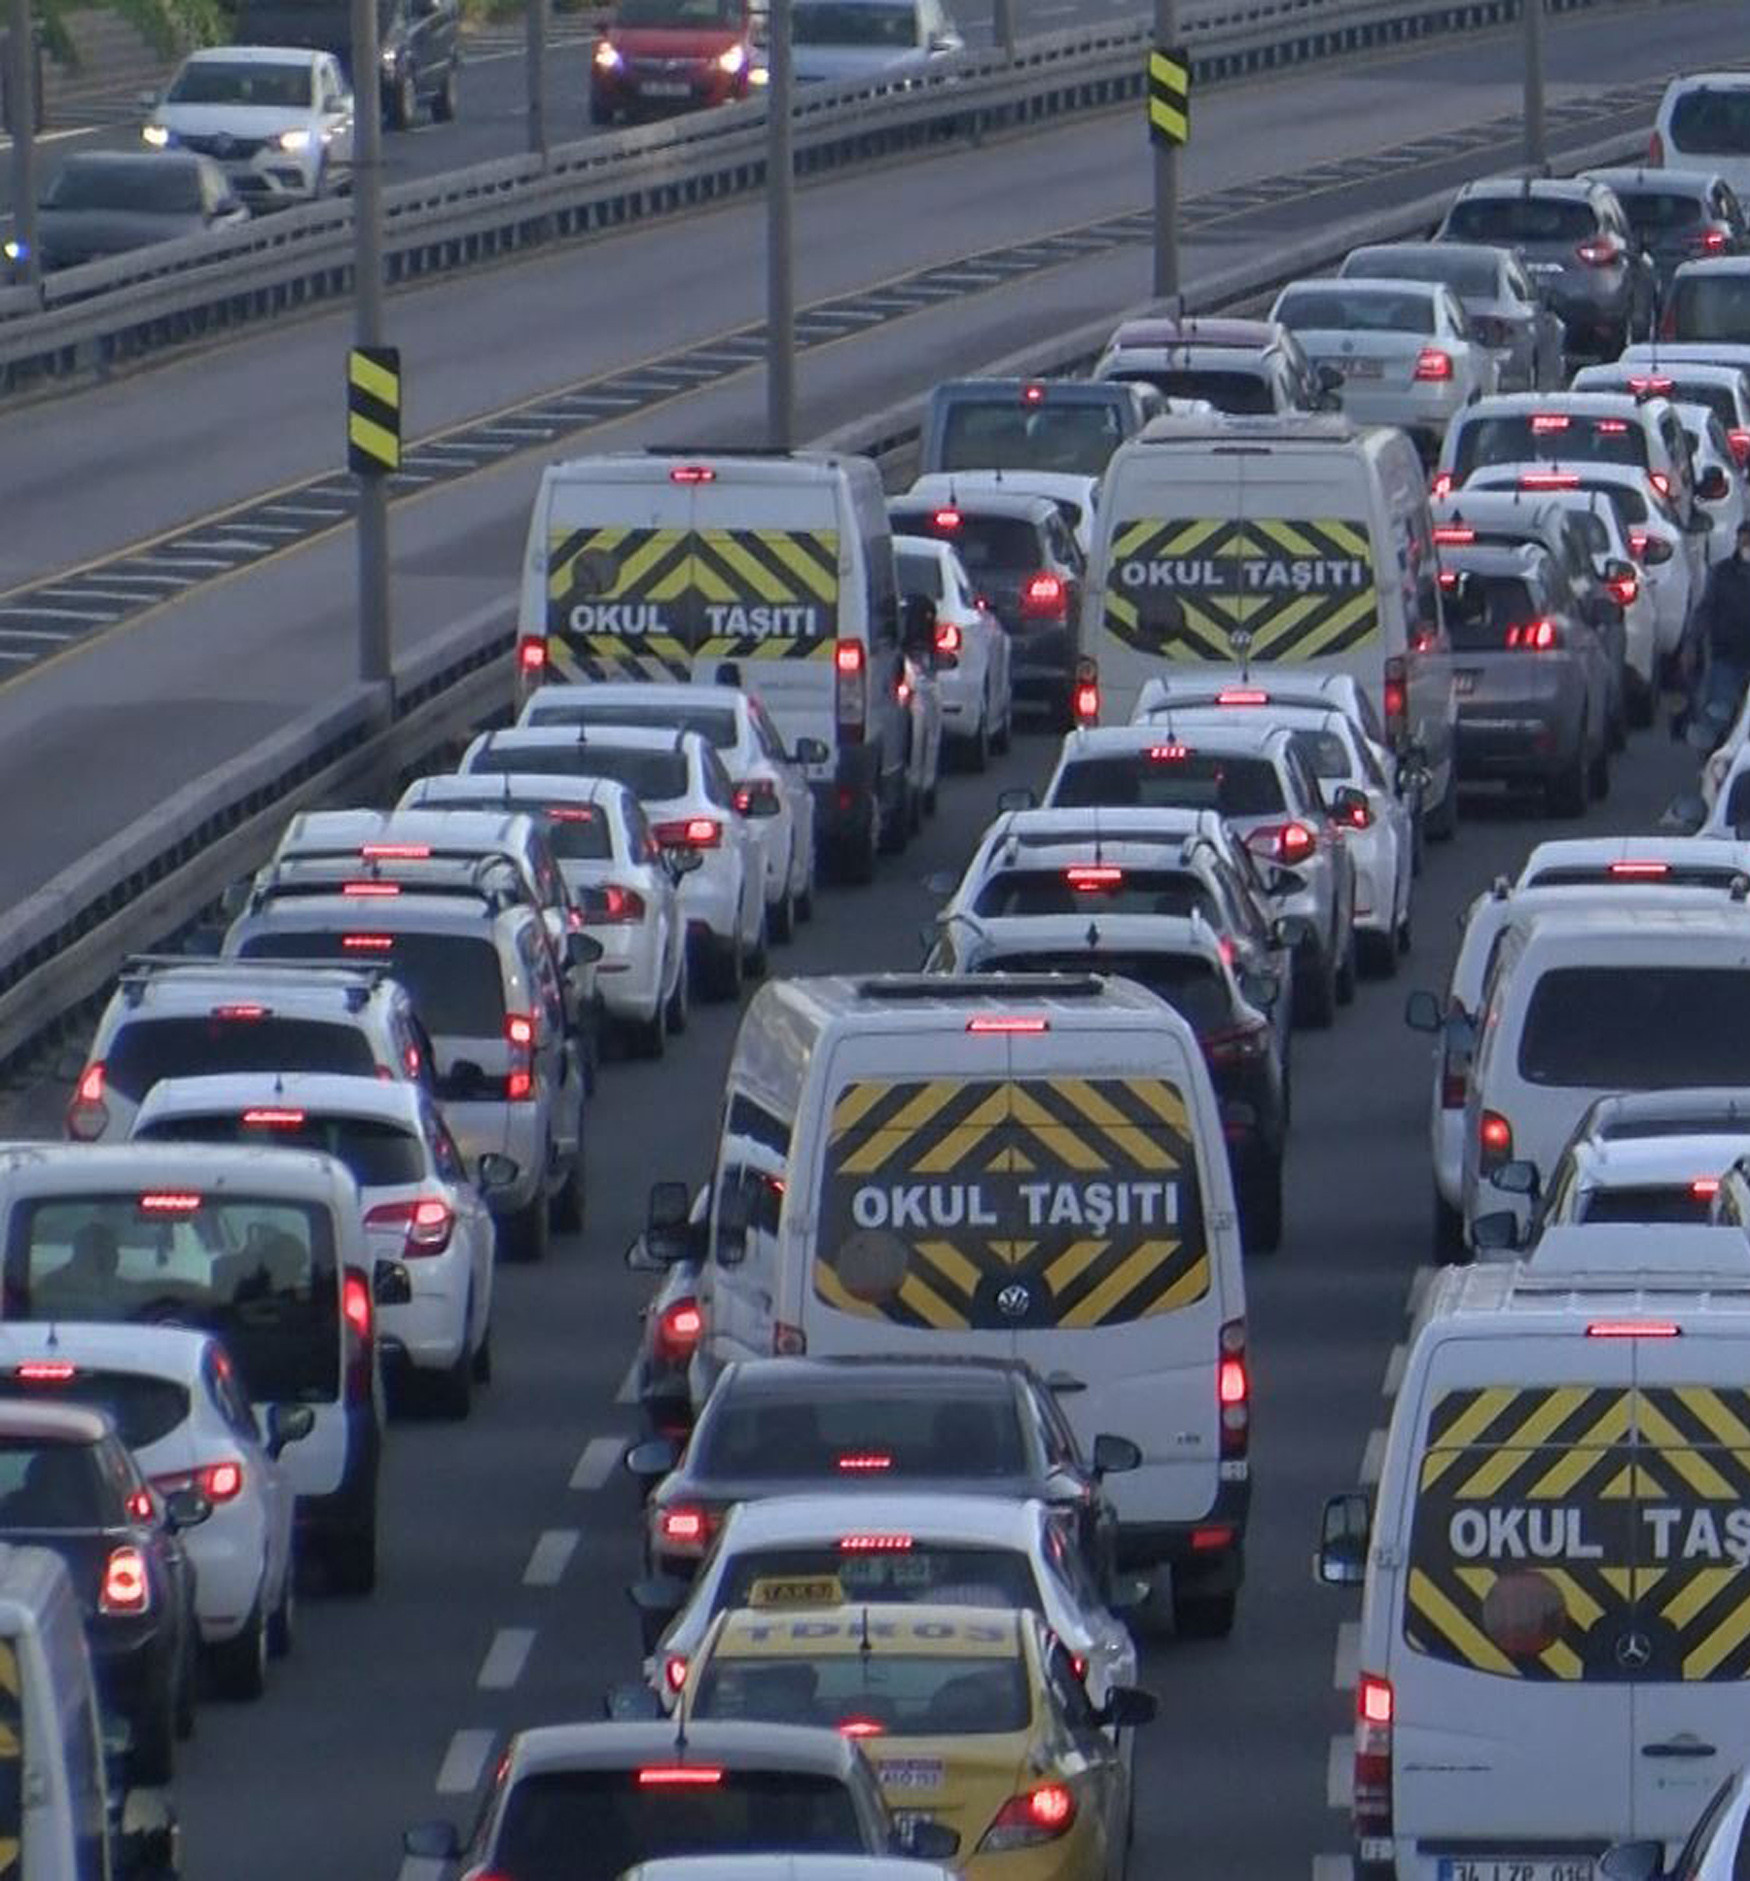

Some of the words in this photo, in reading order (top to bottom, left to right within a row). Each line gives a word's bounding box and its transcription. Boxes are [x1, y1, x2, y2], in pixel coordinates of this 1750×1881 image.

[1121, 561, 1224, 585] OKUL
[1244, 561, 1362, 591] TAŞITI
[569, 605, 669, 634] OKUL
[704, 605, 817, 641] TAŞITI
[851, 1185, 997, 1227] OKUL
[1018, 1182, 1178, 1236] TAŞITI
[1449, 1508, 1604, 1558] OKUL
